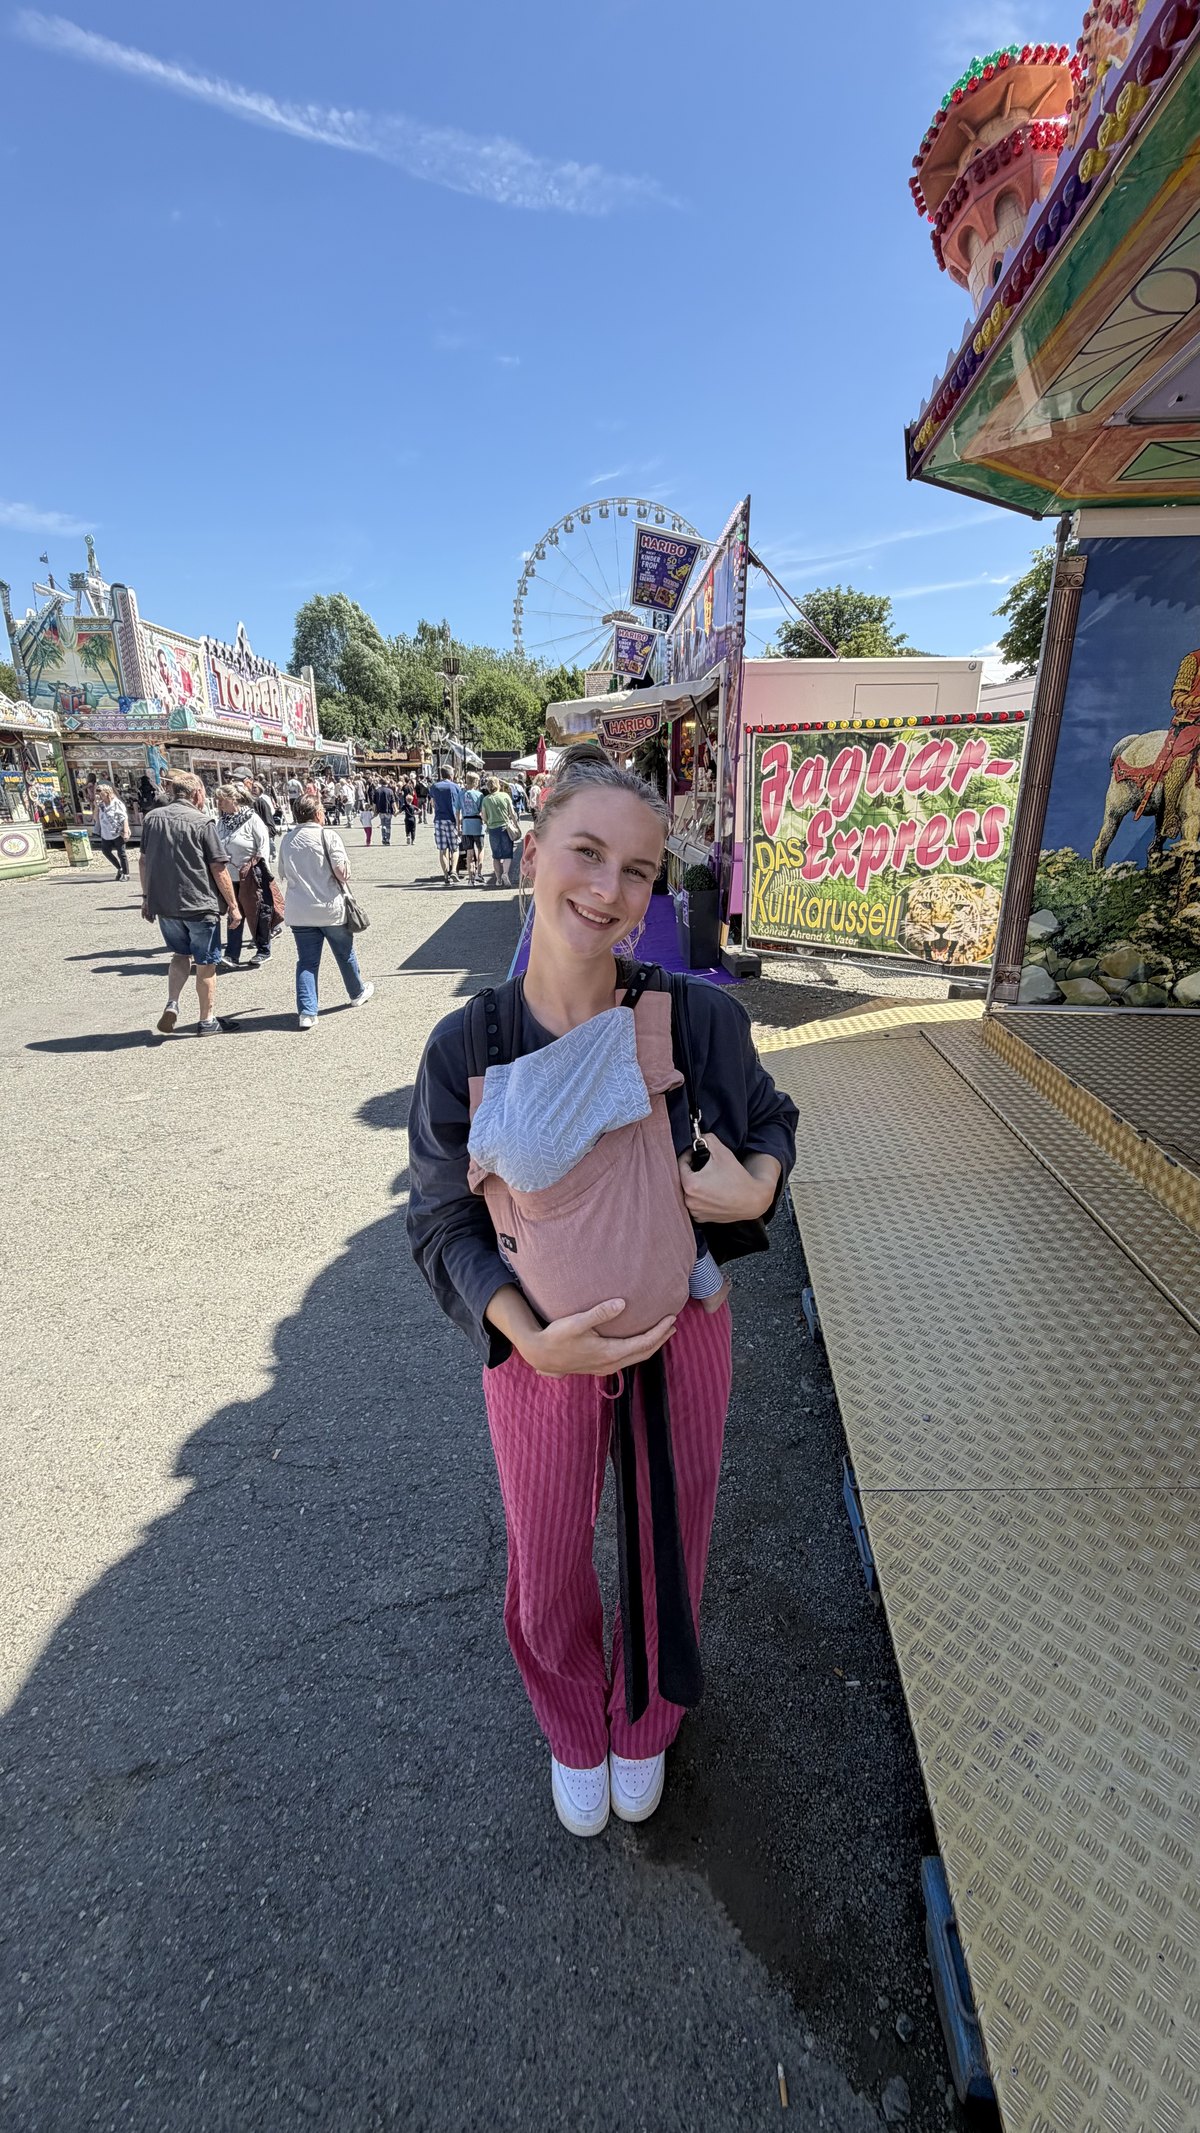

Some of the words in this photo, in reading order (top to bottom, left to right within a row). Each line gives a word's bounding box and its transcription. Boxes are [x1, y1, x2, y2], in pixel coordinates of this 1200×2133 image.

[641, 535, 687, 558] HARIBO
[641, 554, 661, 563] KINDER
[641, 561, 658, 569] FROH
[667, 557, 677, 565] 50
[618, 629, 648, 642] HARIBO
[610, 716, 654, 735] HARIBO
[755, 838, 805, 874] DAS
[801, 805, 1010, 893] Express
[751, 868, 901, 938] Kultkarussell
[758, 925, 788, 937] Konrad
[790, 929, 822, 941] Ahrend
[823, 933, 831, 942] &
[834, 934, 859, 946] Vater
